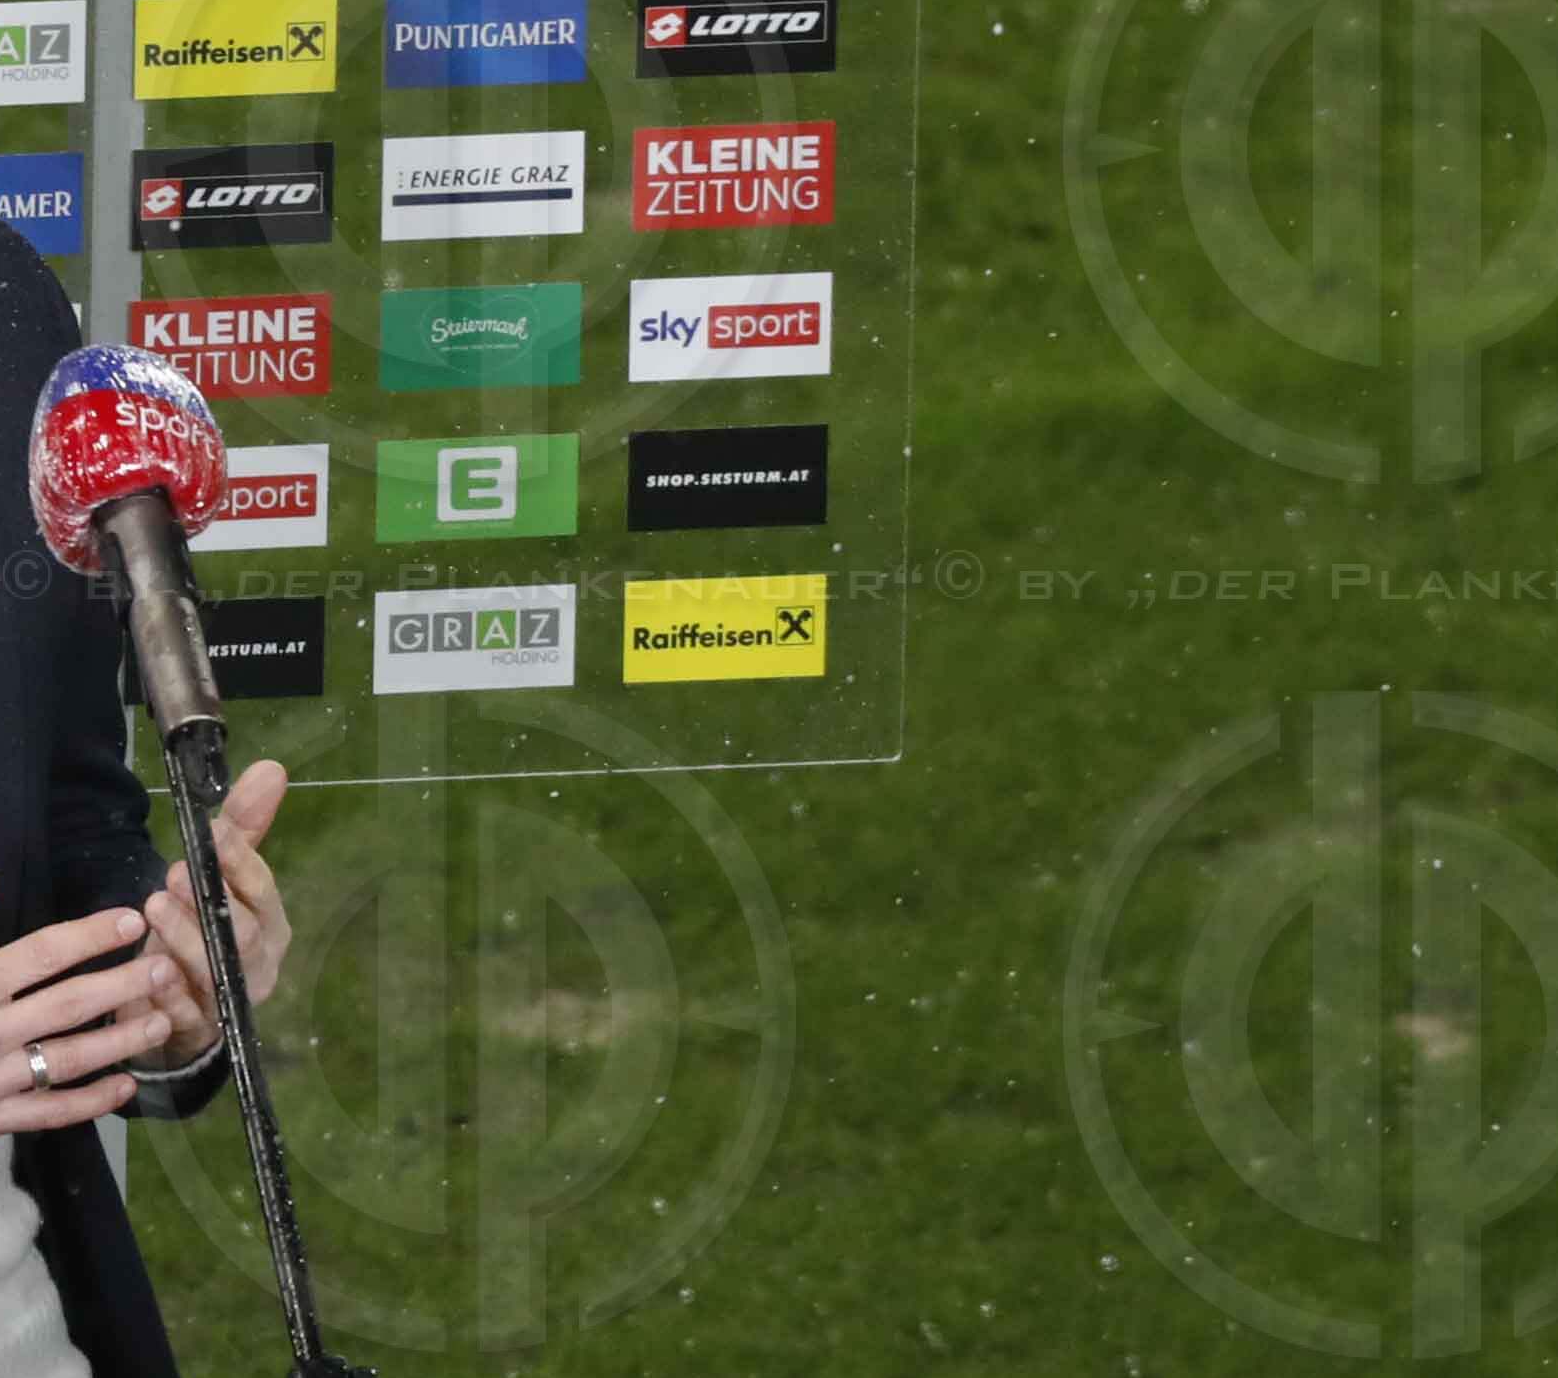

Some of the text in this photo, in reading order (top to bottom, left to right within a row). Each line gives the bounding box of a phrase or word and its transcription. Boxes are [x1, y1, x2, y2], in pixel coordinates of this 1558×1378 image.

[393, 19, 576, 52] PUNTIGAMER
[689, 10, 822, 37] LOTTO
[144, 39, 284, 67] Raiffeisen
[645, 134, 821, 175] KLEINE
[409, 164, 571, 189] ENERGIE GRAZ
[644, 175, 820, 216] ZEITUNG
[142, 306, 318, 347] KLEINE
[429, 316, 529, 344] Steiermark
[638, 309, 814, 349] sky sport
[115, 400, 217, 461] sport
[645, 469, 811, 488] SHOP.SKSTURM.AT
[393, 614, 553, 650] GRAZ
